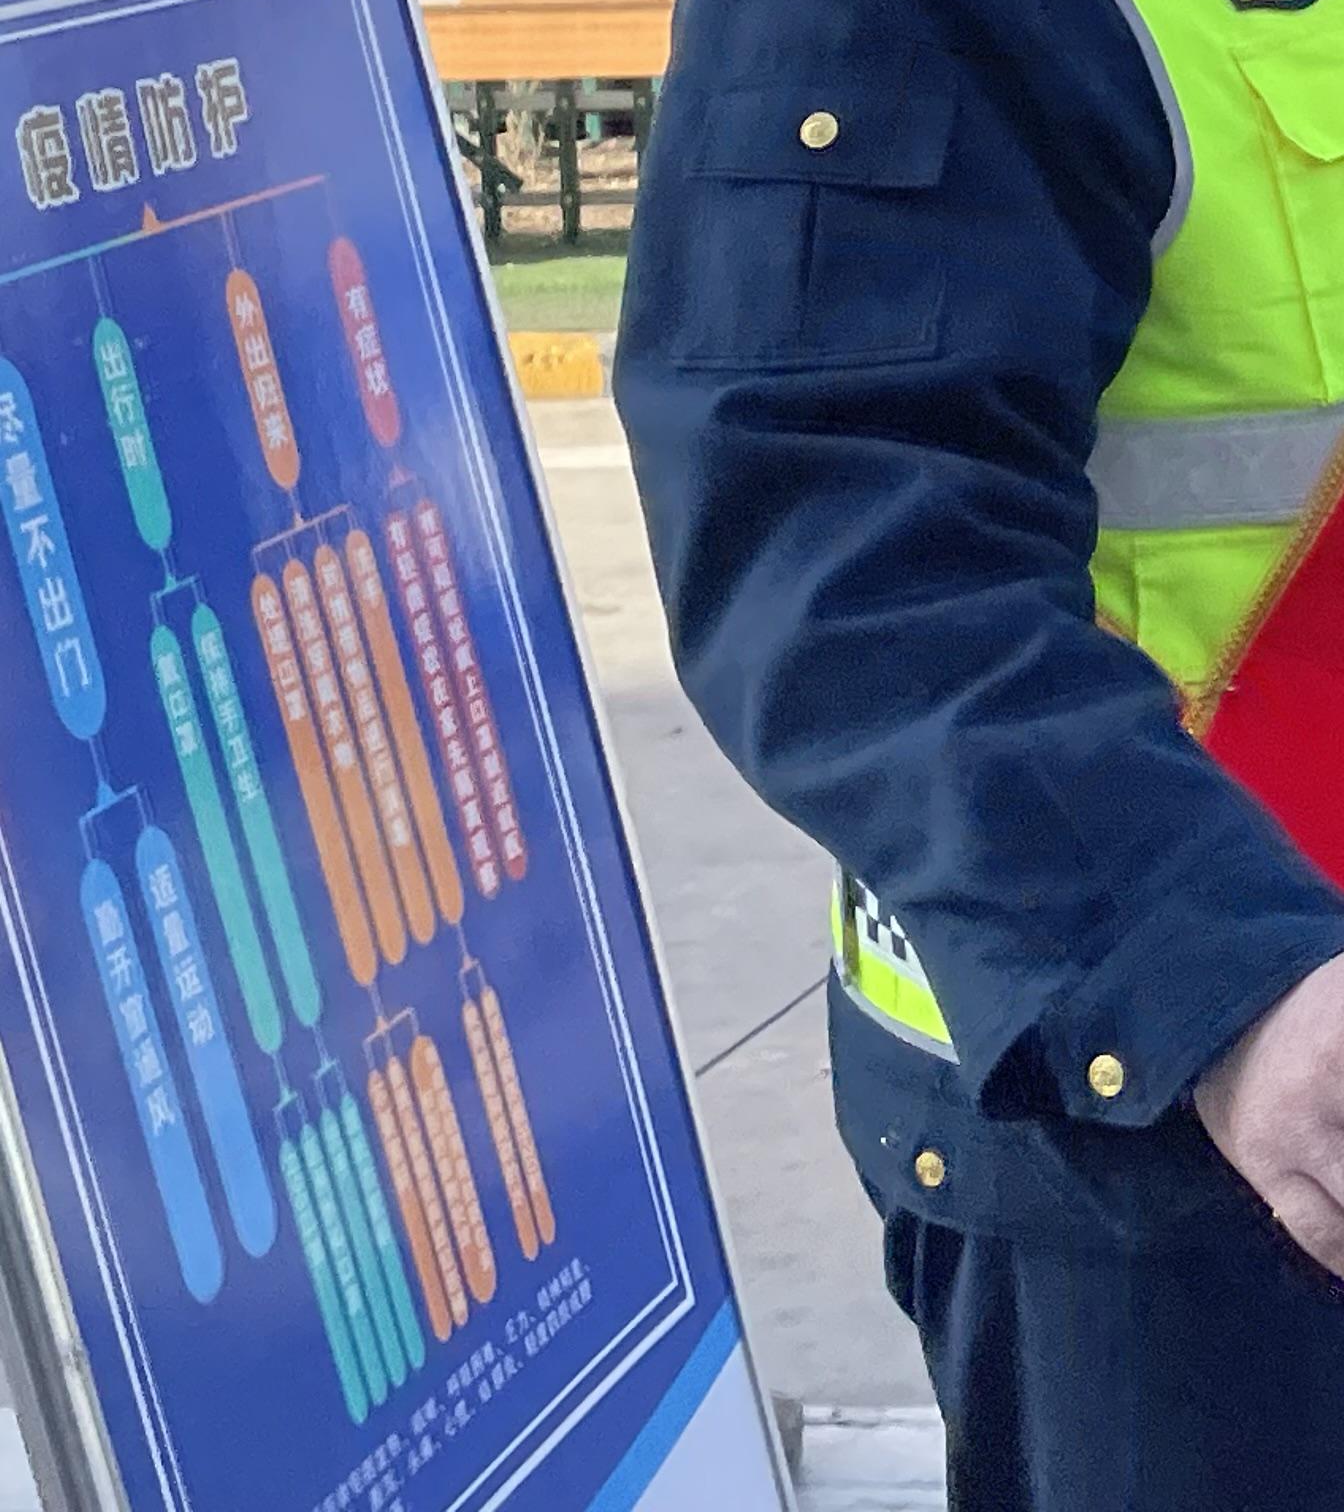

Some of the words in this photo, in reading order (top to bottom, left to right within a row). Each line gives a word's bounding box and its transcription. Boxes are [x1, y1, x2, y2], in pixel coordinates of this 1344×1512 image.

[17, 57, 250, 209] 疫情防护
[233, 297, 289, 450] 外出归来
[345, 285, 390, 399] 有症状
[200, 631, 258, 803] 保持手卫生
[93, 898, 176, 1137] 勤开窗通风
[148, 863, 216, 1047] 适量运动
